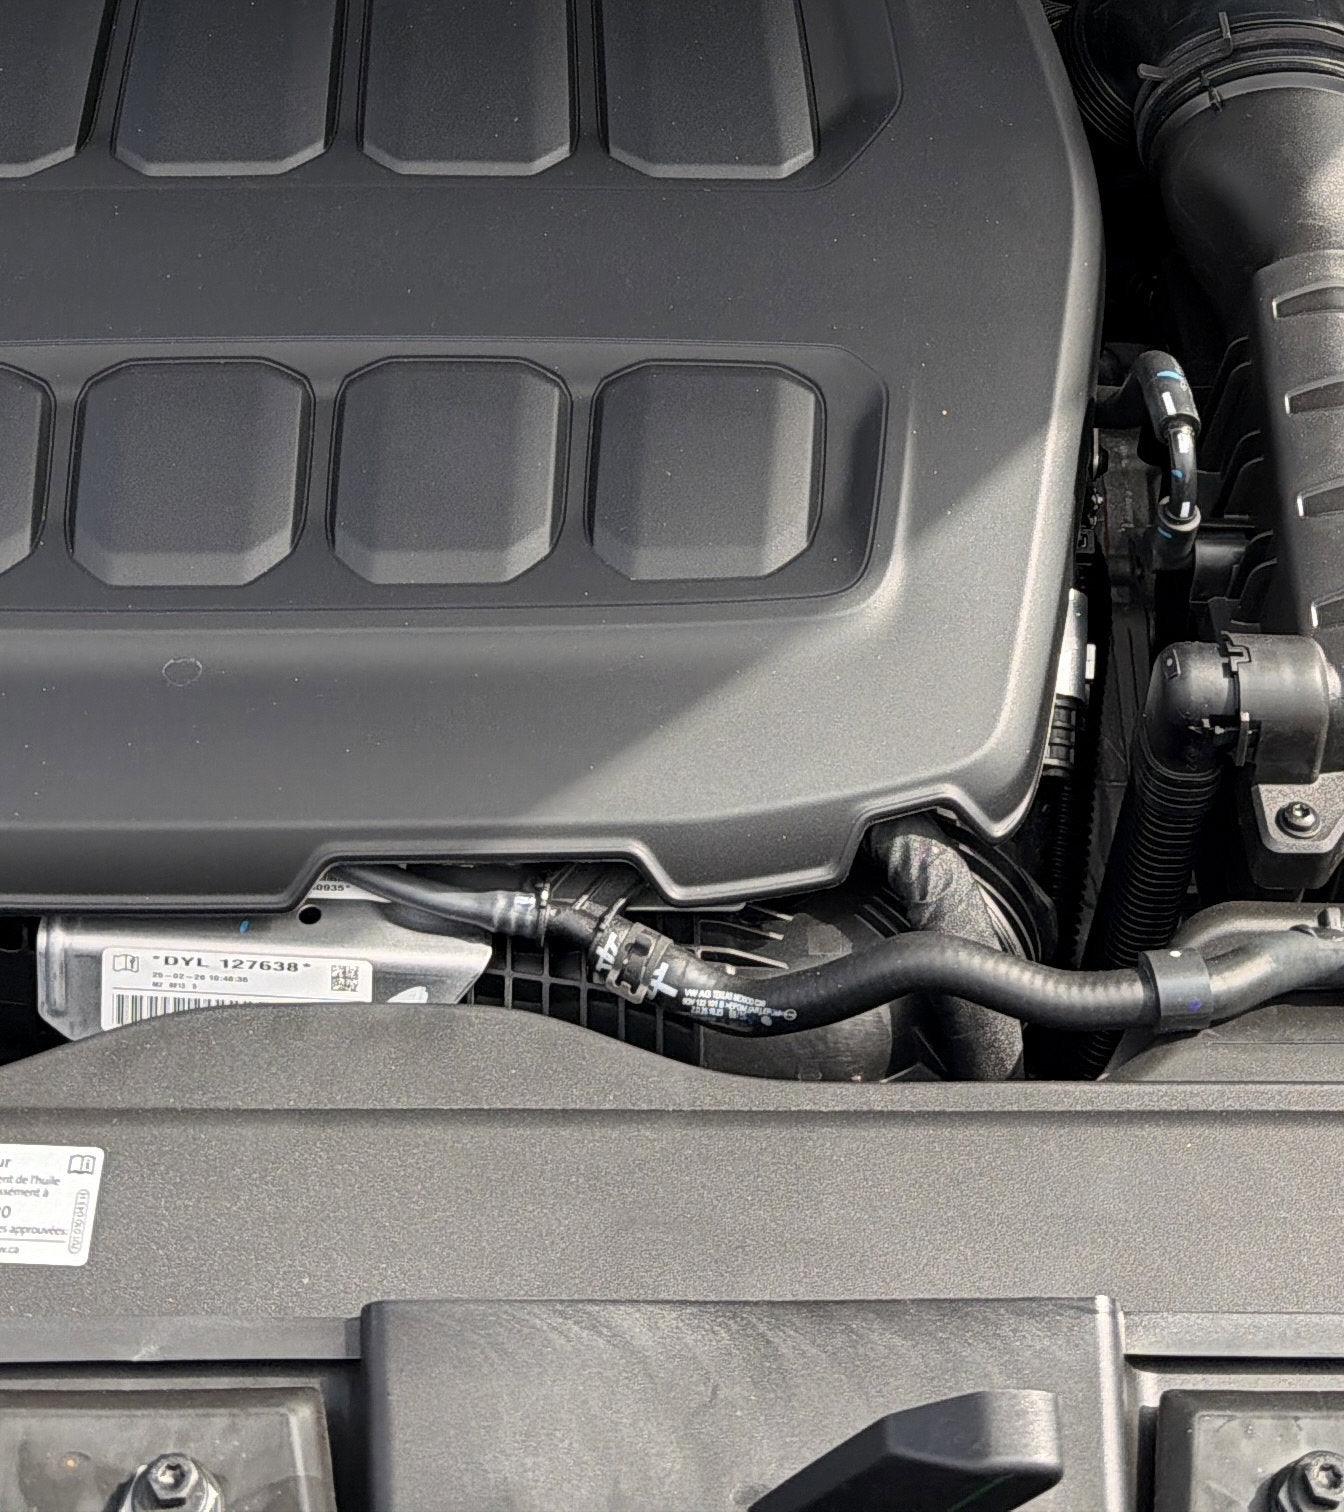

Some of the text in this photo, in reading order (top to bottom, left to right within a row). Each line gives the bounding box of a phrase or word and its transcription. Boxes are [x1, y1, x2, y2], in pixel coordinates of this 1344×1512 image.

[15, 1175, 28, 1185] de
[30, 1175, 60, 1185] l'huile
[42, 1188, 49, 1198] à
